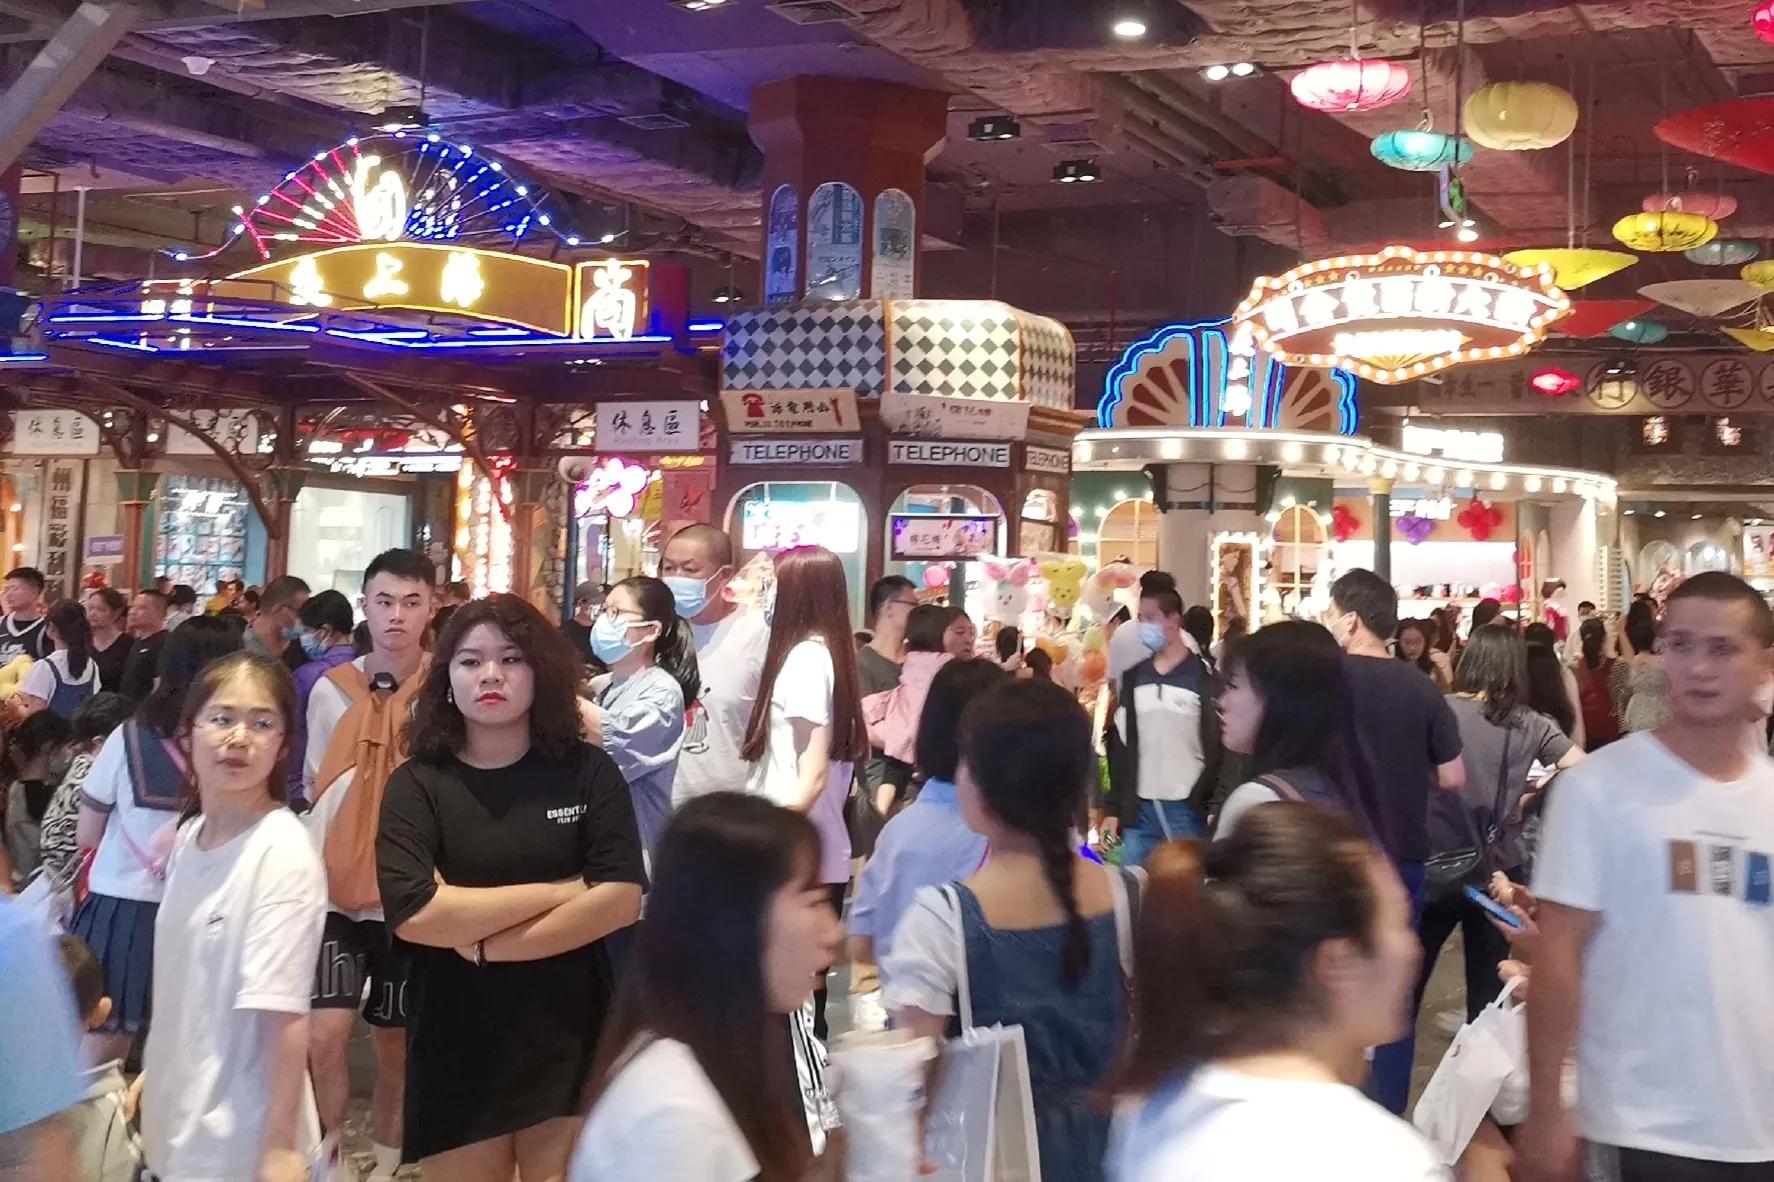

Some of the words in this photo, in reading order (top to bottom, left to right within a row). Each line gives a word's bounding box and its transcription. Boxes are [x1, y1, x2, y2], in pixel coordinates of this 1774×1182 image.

[611, 409, 682, 435] 休息區
[743, 444, 850, 460] TELEPHONE
[892, 445, 1008, 463] TELEPHONE
